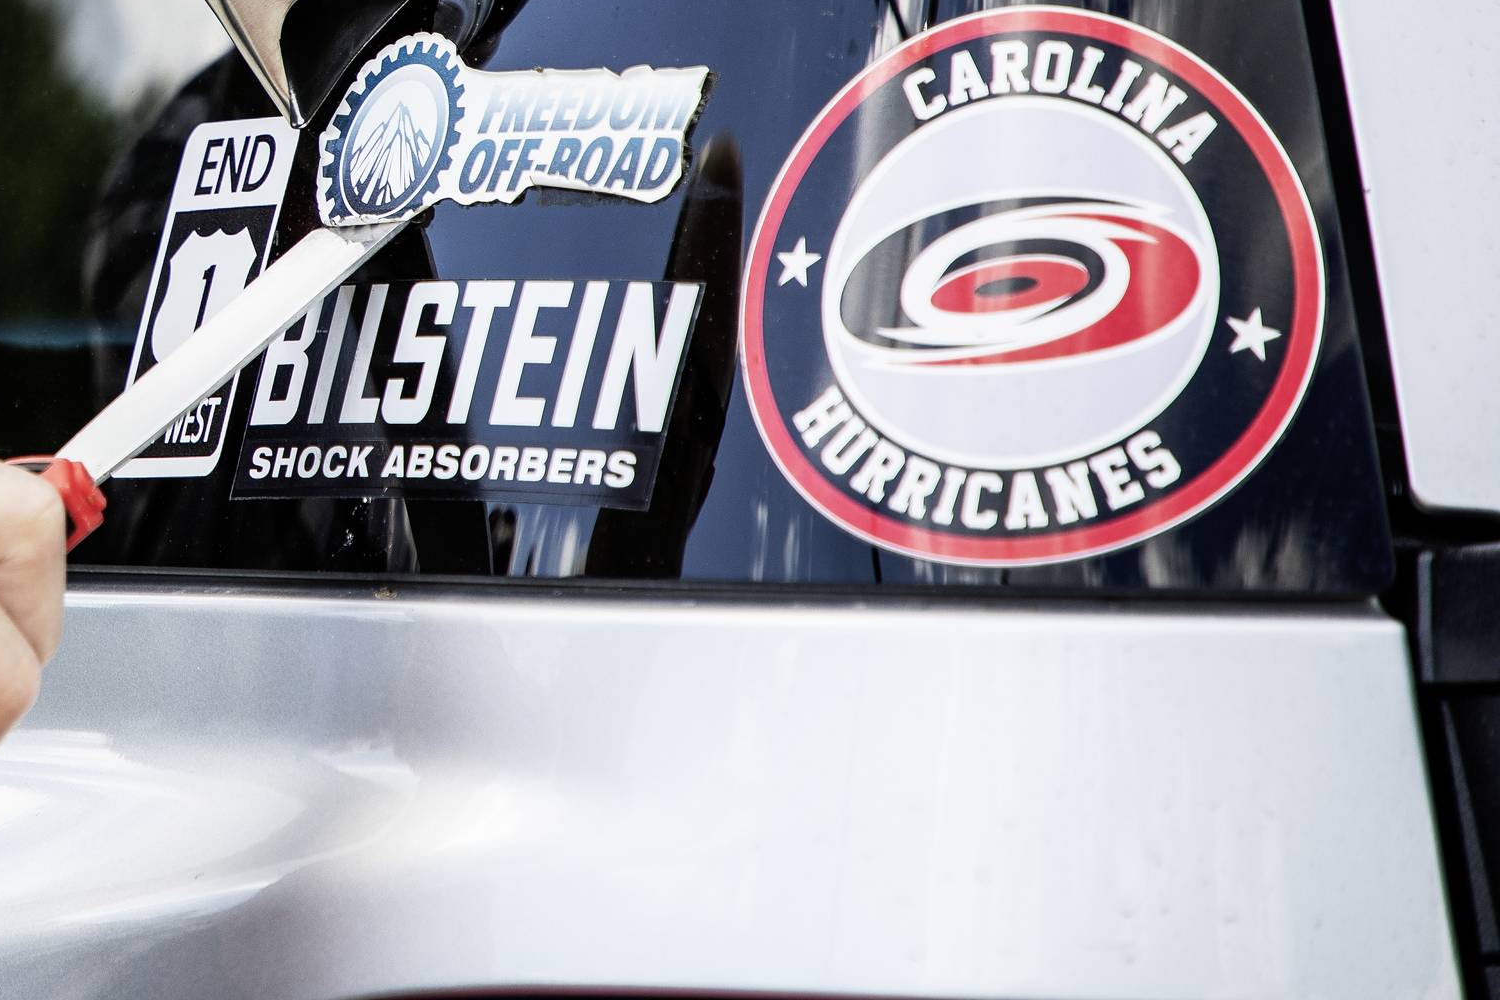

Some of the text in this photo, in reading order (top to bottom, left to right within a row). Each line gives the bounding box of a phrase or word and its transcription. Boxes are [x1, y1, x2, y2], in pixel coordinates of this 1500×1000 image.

[476, 78, 697, 135] FREEDOM
[902, 38, 1219, 166] CAROLINA
[193, 133, 277, 196] END
[458, 135, 683, 195] OFF-ROAD
[193, 264, 218, 334] 1
[250, 281, 700, 433] BILSTEIN
[248, 444, 638, 489] SHOCK ABSORBERS
[791, 384, 1182, 531] HURRICANES
